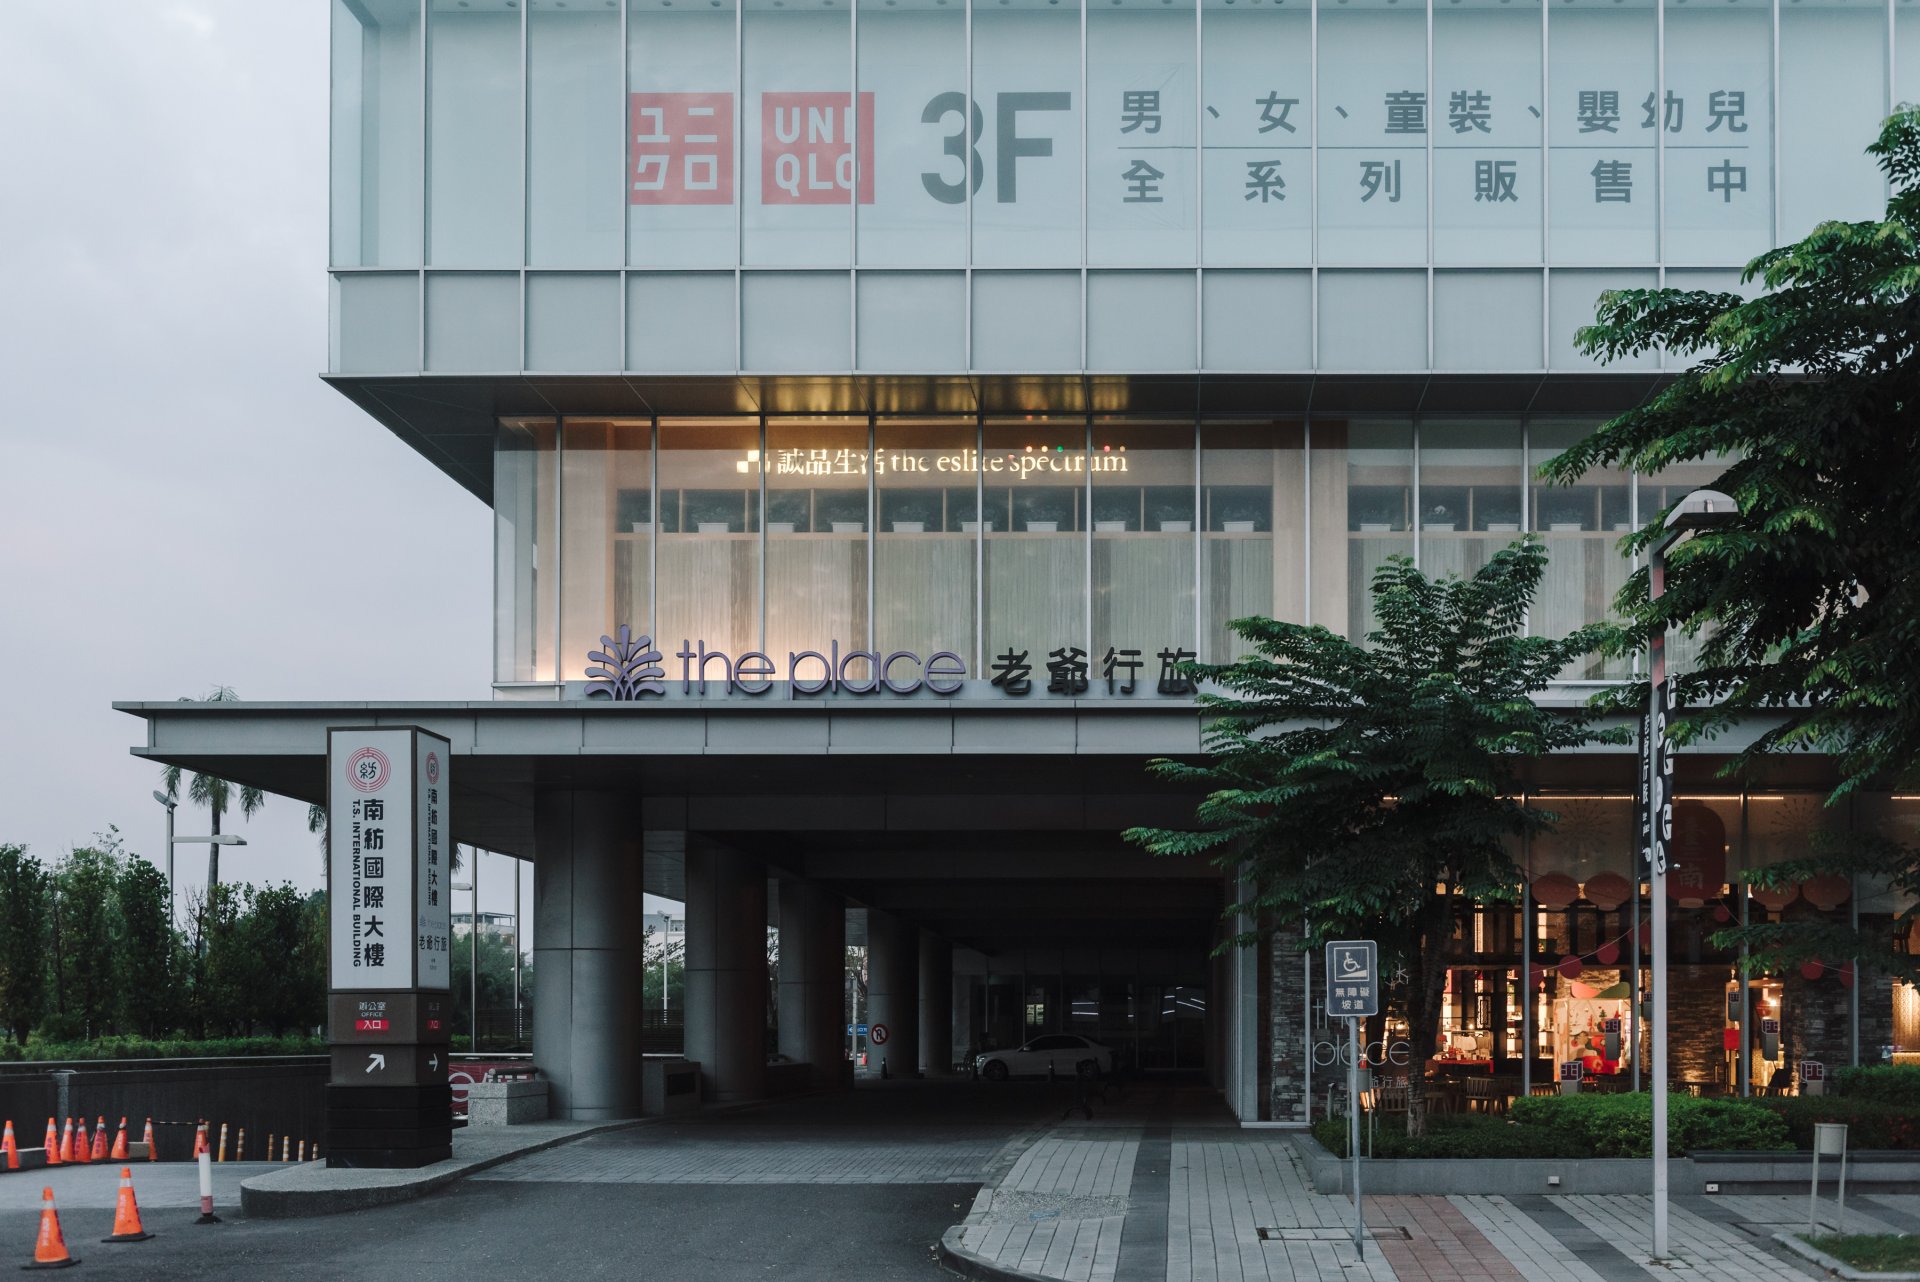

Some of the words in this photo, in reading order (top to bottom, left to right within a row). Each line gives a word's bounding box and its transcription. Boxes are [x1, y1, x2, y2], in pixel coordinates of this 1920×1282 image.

[920, 91, 1072, 204] 3F
[1121, 160, 1748, 203] 全系列販售中
[777, 448, 886, 476] 誠品生活
[891, 450, 929, 472] the
[936, 449, 1004, 472] eslite
[1009, 453, 1128, 480] spectrum
[676, 639, 774, 695] the
[788, 639, 967, 700] place
[990, 646, 1198, 696] 老爺行旅
[352, 799, 361, 819] T.S.
[352, 821, 361, 911] INTERNATIONAL
[363, 798, 385, 968] 南紡國際大樓
[352, 914, 361, 968] BUILDING
[1335, 987, 1370, 998] 無障礙
[1341, 999, 1364, 1010] 坡道
[363, 1020, 382, 1029] 入口
